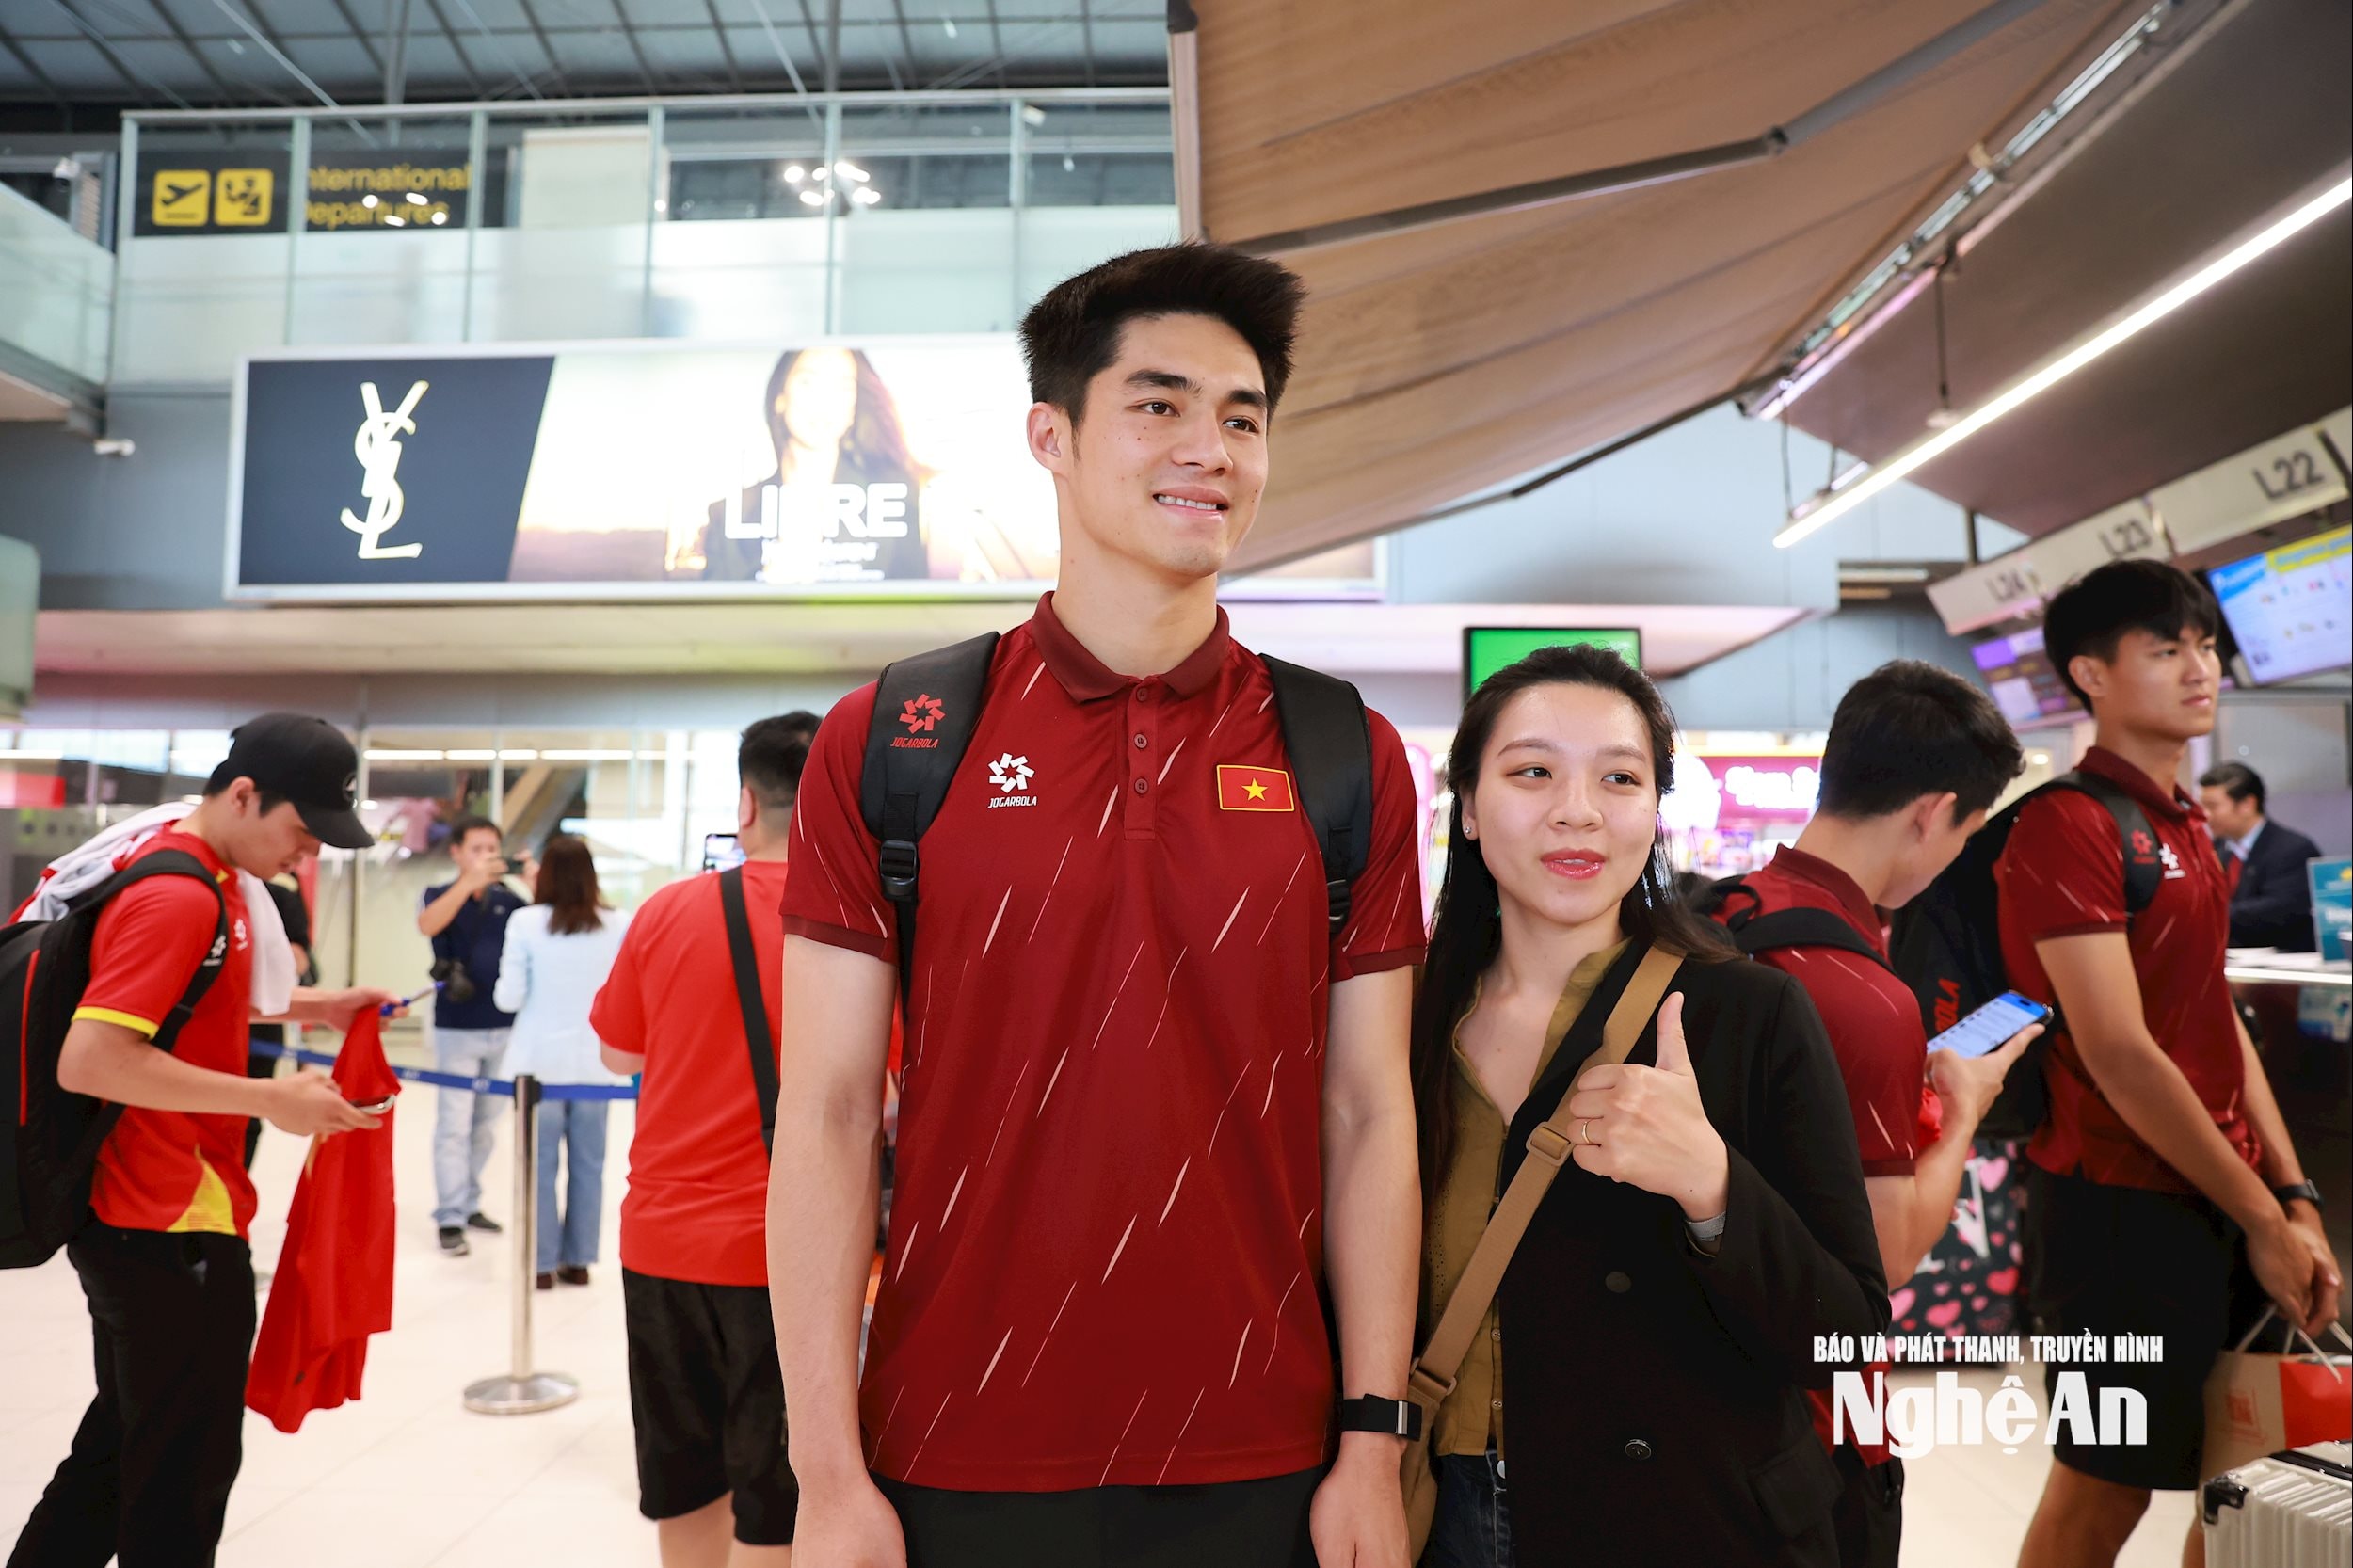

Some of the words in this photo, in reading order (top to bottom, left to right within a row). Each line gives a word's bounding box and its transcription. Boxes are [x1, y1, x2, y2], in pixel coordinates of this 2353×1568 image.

[308, 162, 473, 191] nternational
[305, 199, 451, 230] epartures
[2252, 449, 2325, 501] L22
[725, 482, 908, 539] LIRE
[2098, 519, 2152, 562] L23
[890, 737, 939, 749] JOGARBOLA
[988, 796, 1037, 808] JOGARBOLA
